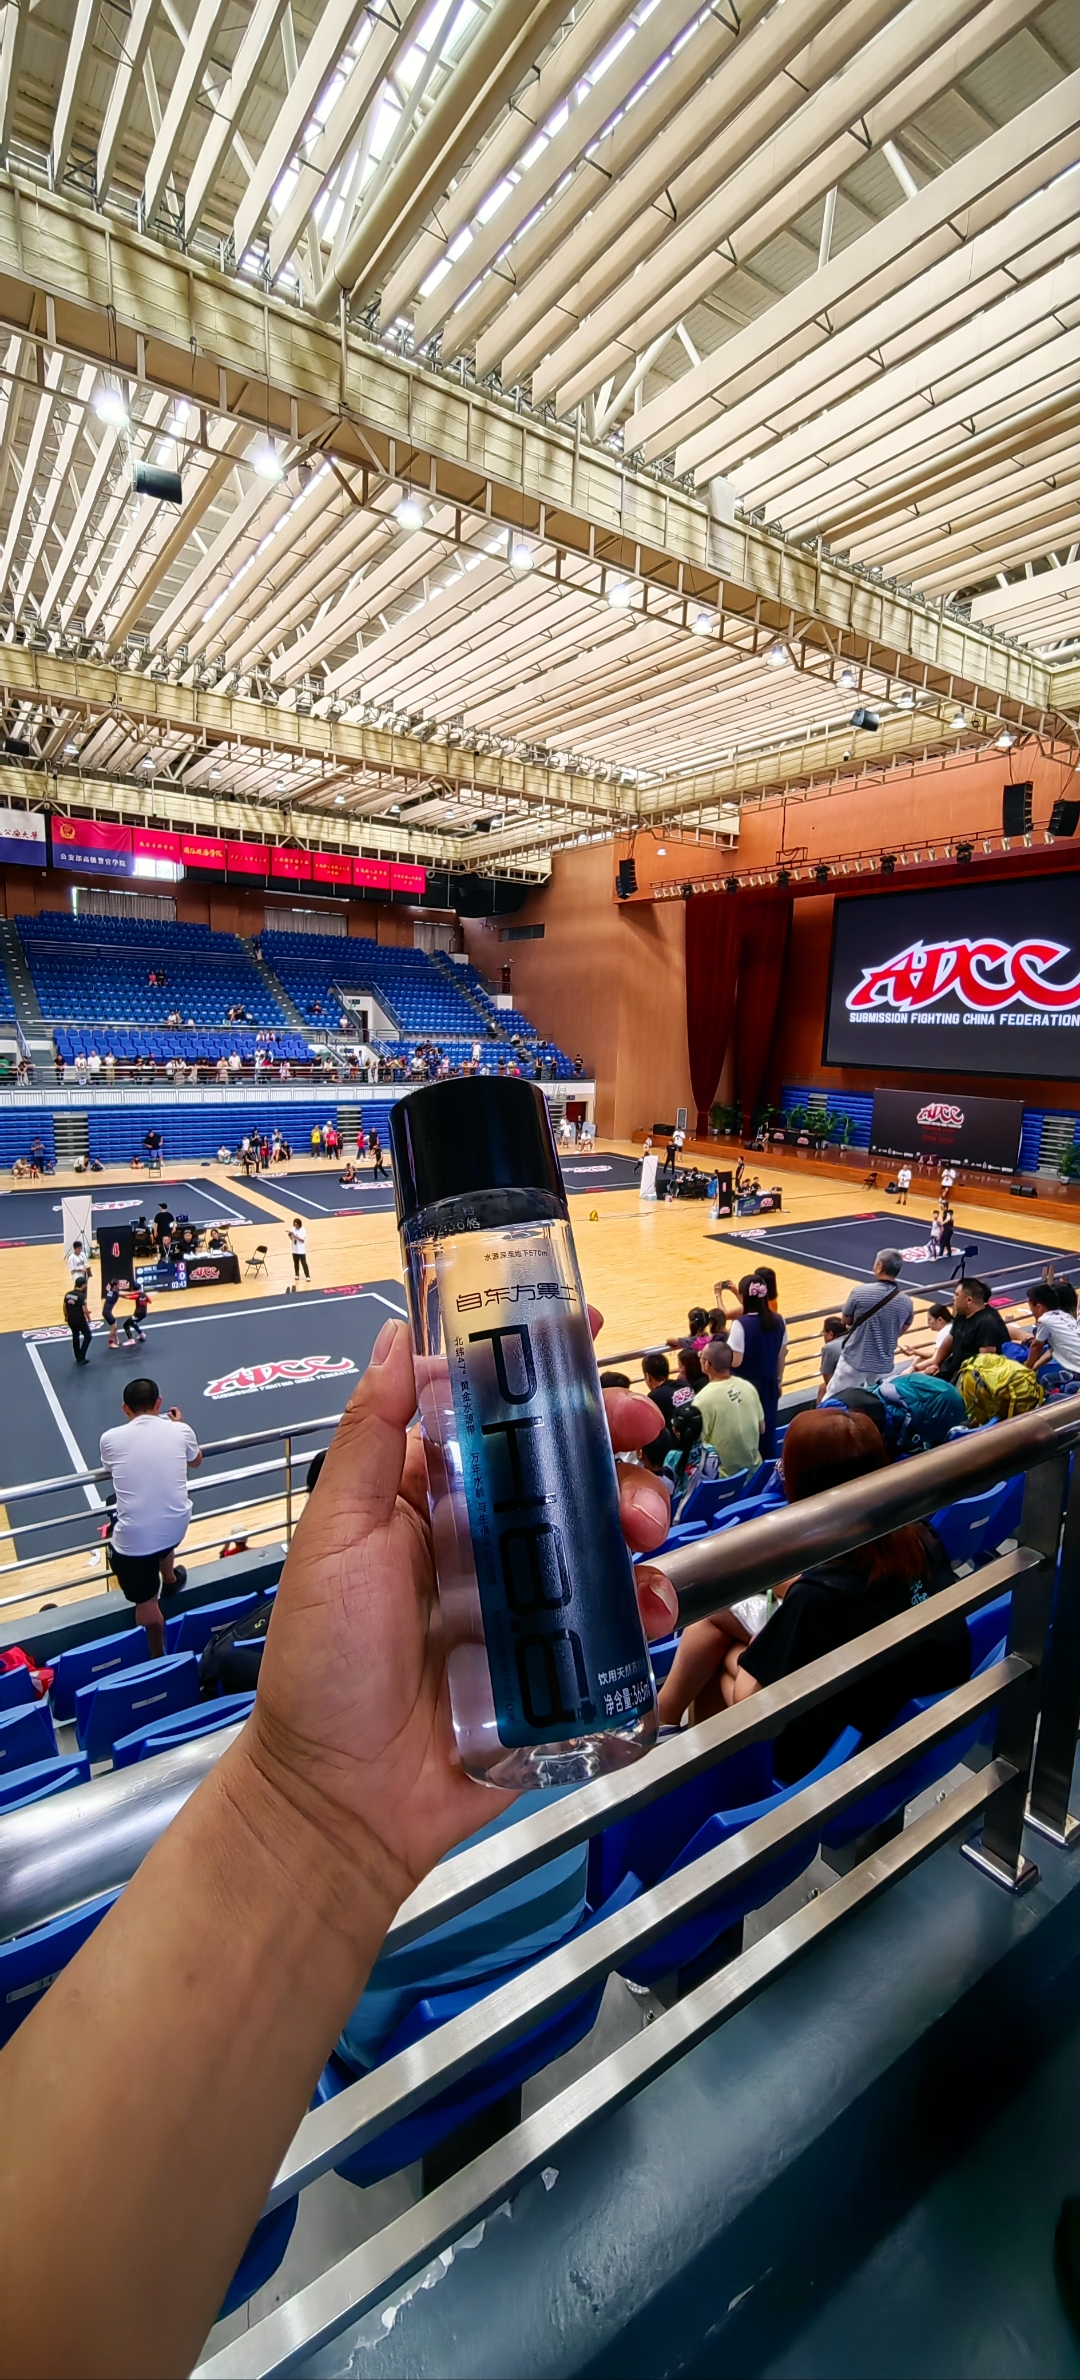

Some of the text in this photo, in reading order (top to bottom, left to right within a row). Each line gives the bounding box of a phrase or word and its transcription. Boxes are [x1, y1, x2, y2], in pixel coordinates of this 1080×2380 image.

[846, 938, 1080, 1012] ADCC
[850, 1012, 1080, 1027] SUBMISSION FIGHTING CHINA FEDERATION
[203, 1355, 355, 1397] ADCC
[259, 1380, 294, 1392] FIGHTING
